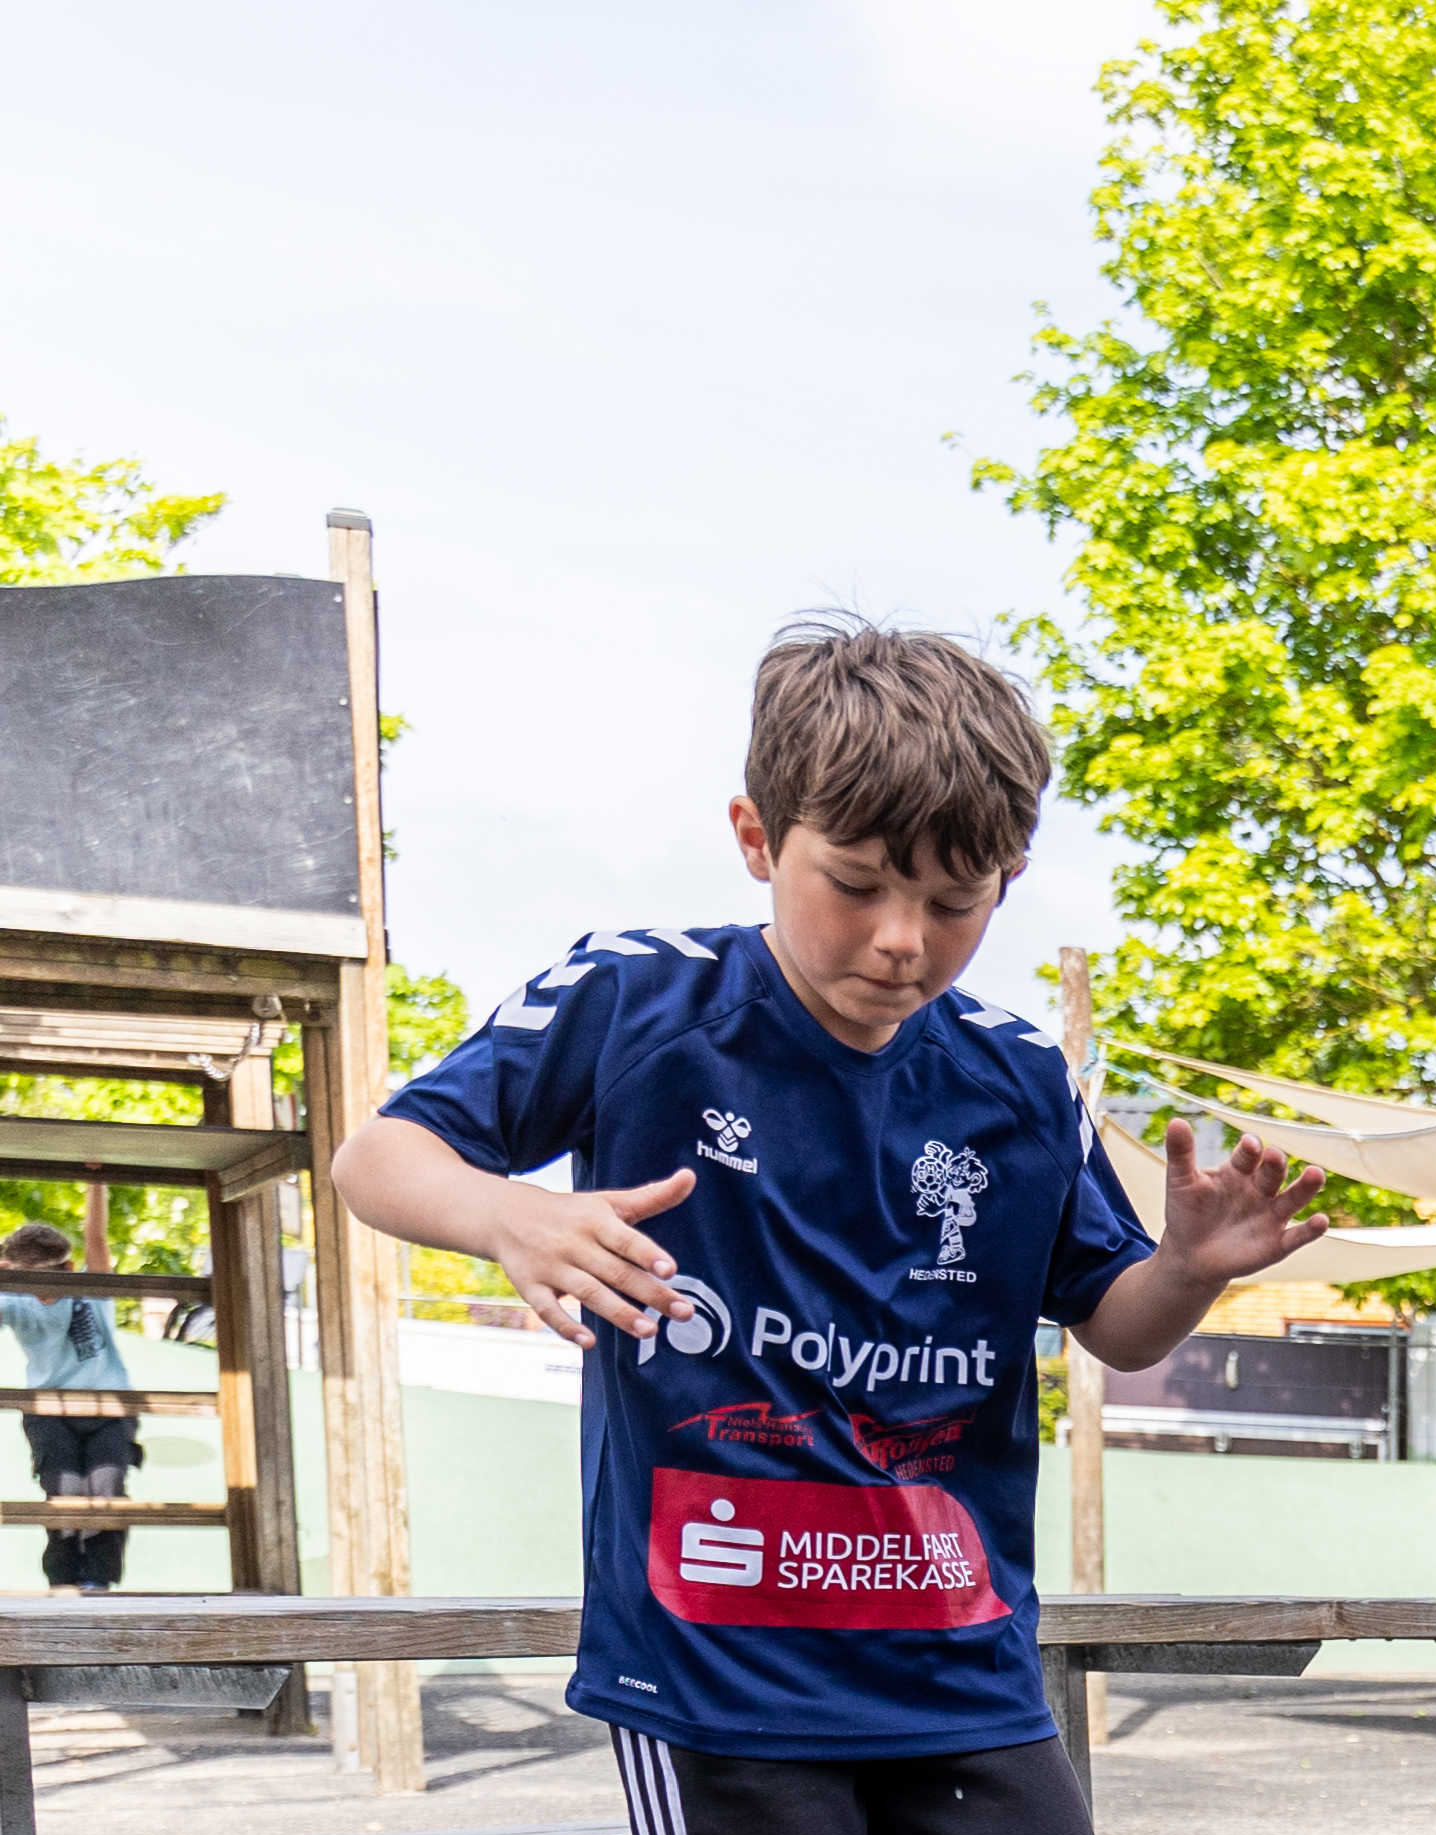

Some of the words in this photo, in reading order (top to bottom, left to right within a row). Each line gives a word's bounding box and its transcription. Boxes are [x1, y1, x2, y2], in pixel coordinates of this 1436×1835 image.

[697, 1139, 758, 1174] hummel
[751, 1306, 996, 1392] Polyprint
[704, 1414, 816, 1447] Transport
[780, 1531, 964, 1561] MIDDELFART
[777, 1561, 976, 1590] SPAREKASSE
